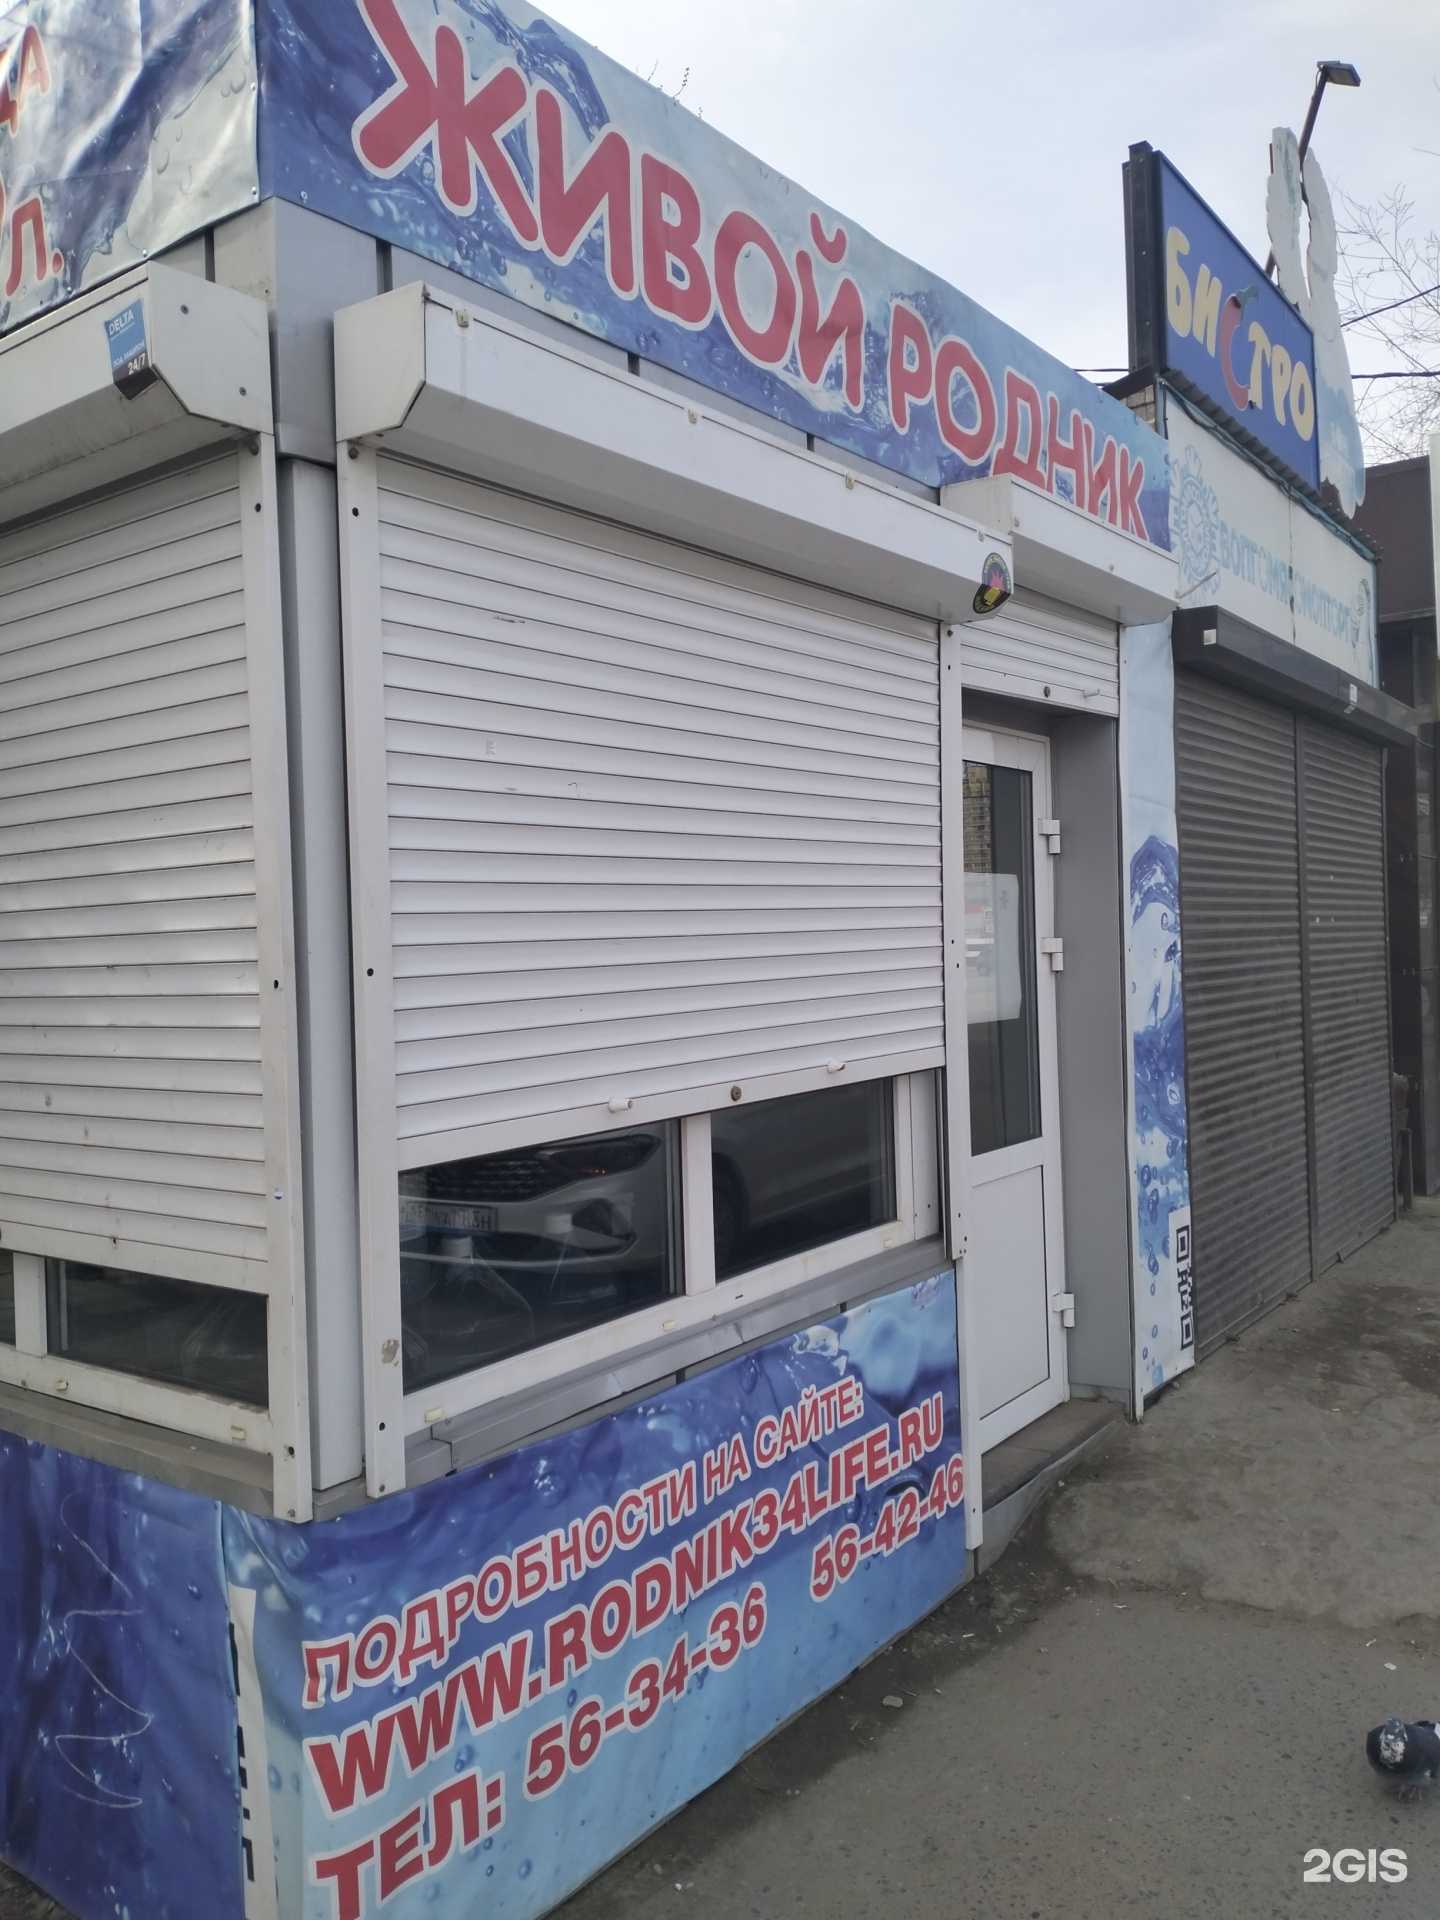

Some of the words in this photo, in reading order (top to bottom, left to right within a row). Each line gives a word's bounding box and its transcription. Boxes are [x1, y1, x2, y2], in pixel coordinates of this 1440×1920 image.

[108, 308, 134, 337] DELTA
[353, 0, 866, 412] ЖИВОЙ
[887, 300, 1150, 542] РОДНИК
[1166, 226, 1315, 442] БИСТРО
[303, 1461, 696, 1708] ПОДРОБНОСТИ
[703, 1432, 751, 1500] НА
[754, 1375, 864, 1467] САЙТЕ:
[303, 1391, 943, 1819] WWW.RODNIK34LIFE.RU
[312, 1773, 504, 1920] ТЕЛ:
[523, 1582, 767, 1799] 56-34-36
[810, 1453, 964, 1600] 56-42-46
